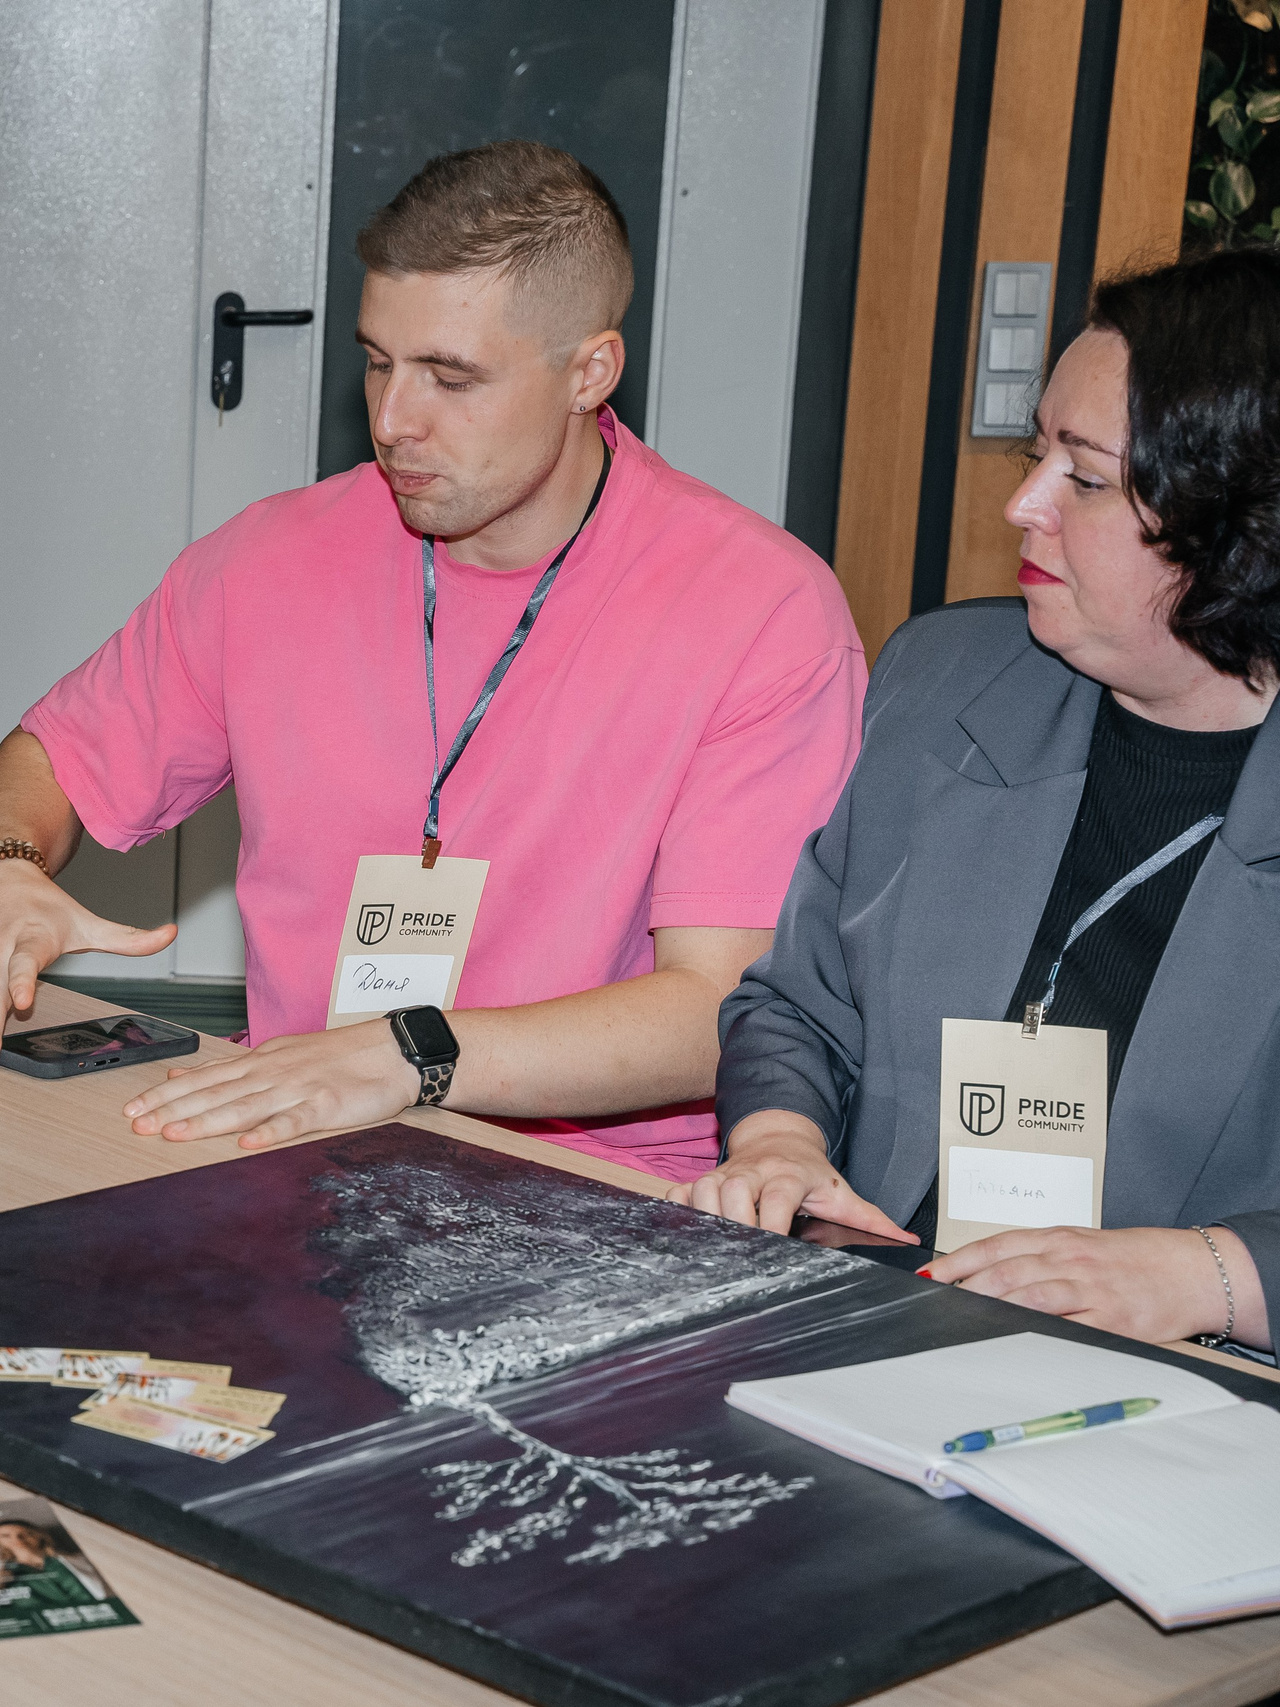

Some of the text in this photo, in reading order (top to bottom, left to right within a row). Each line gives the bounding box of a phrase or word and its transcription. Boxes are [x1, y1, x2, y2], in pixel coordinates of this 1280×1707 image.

[401, 912, 457, 927] PRIDE
[399, 928, 454, 937] COMMUNITY
[1018, 1098, 1086, 1120] PRIDE
[1017, 1118, 1085, 1133] COMMUNITY
